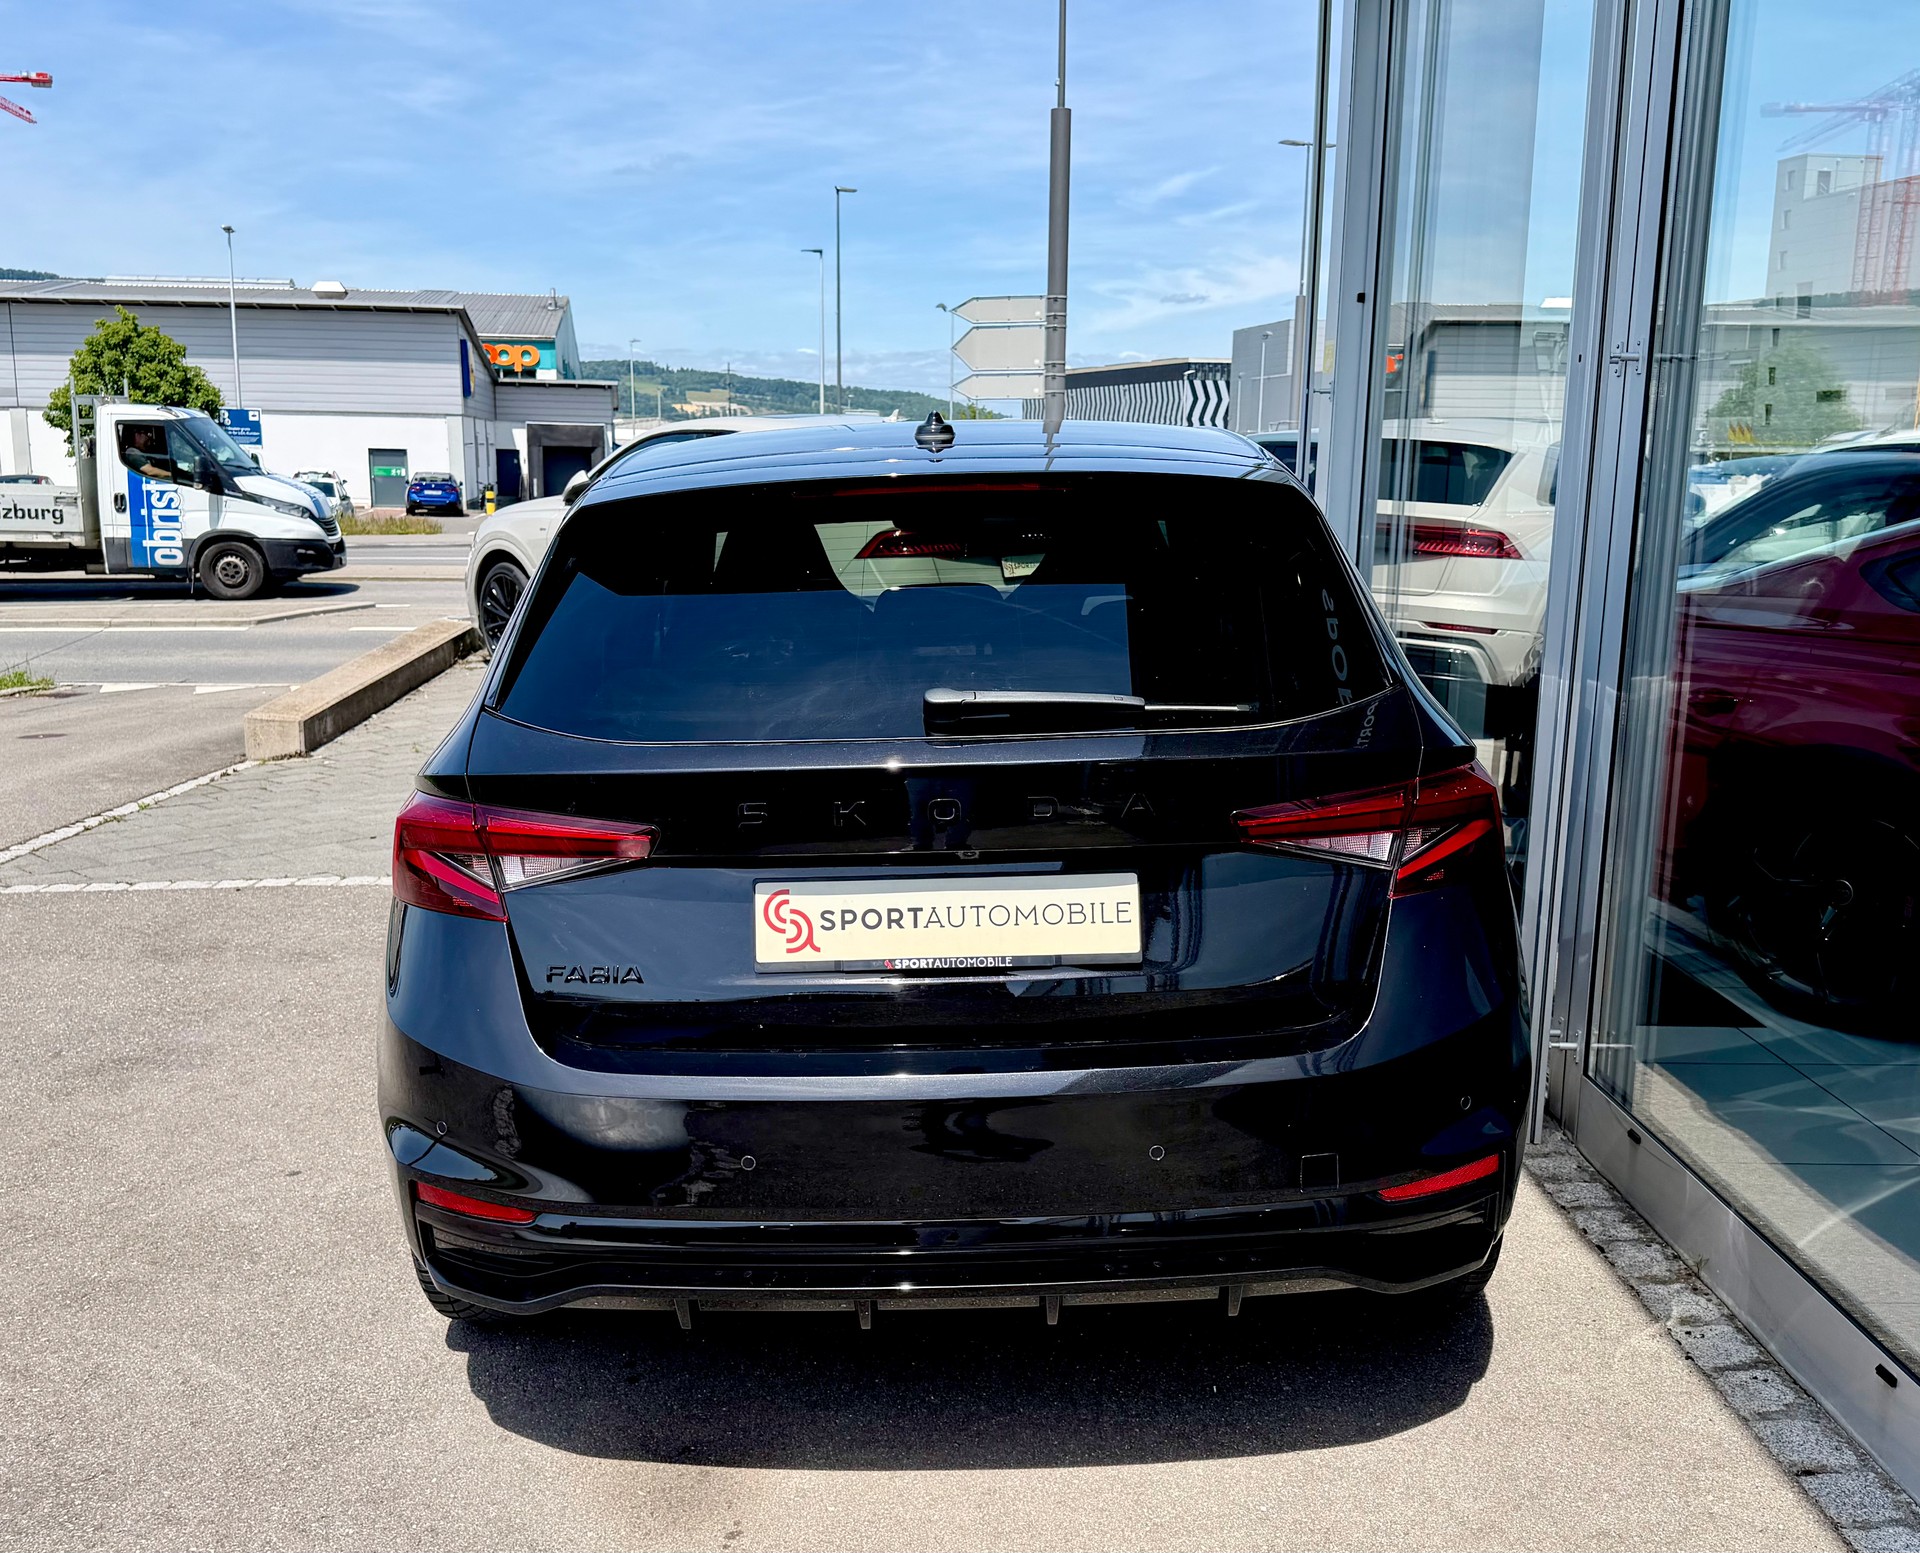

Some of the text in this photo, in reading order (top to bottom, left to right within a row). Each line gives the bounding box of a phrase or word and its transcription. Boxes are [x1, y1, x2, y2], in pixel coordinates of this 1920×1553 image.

[0, 503, 65, 524] zburg
[141, 480, 184, 565] obrist
[737, 793, 1157, 828] SKODA
[819, 901, 1132, 932] SPORTAUTOMOBILE
[546, 964, 645, 984] FABIA
[894, 956, 1013, 969] SPORTAUTOMOBILE
